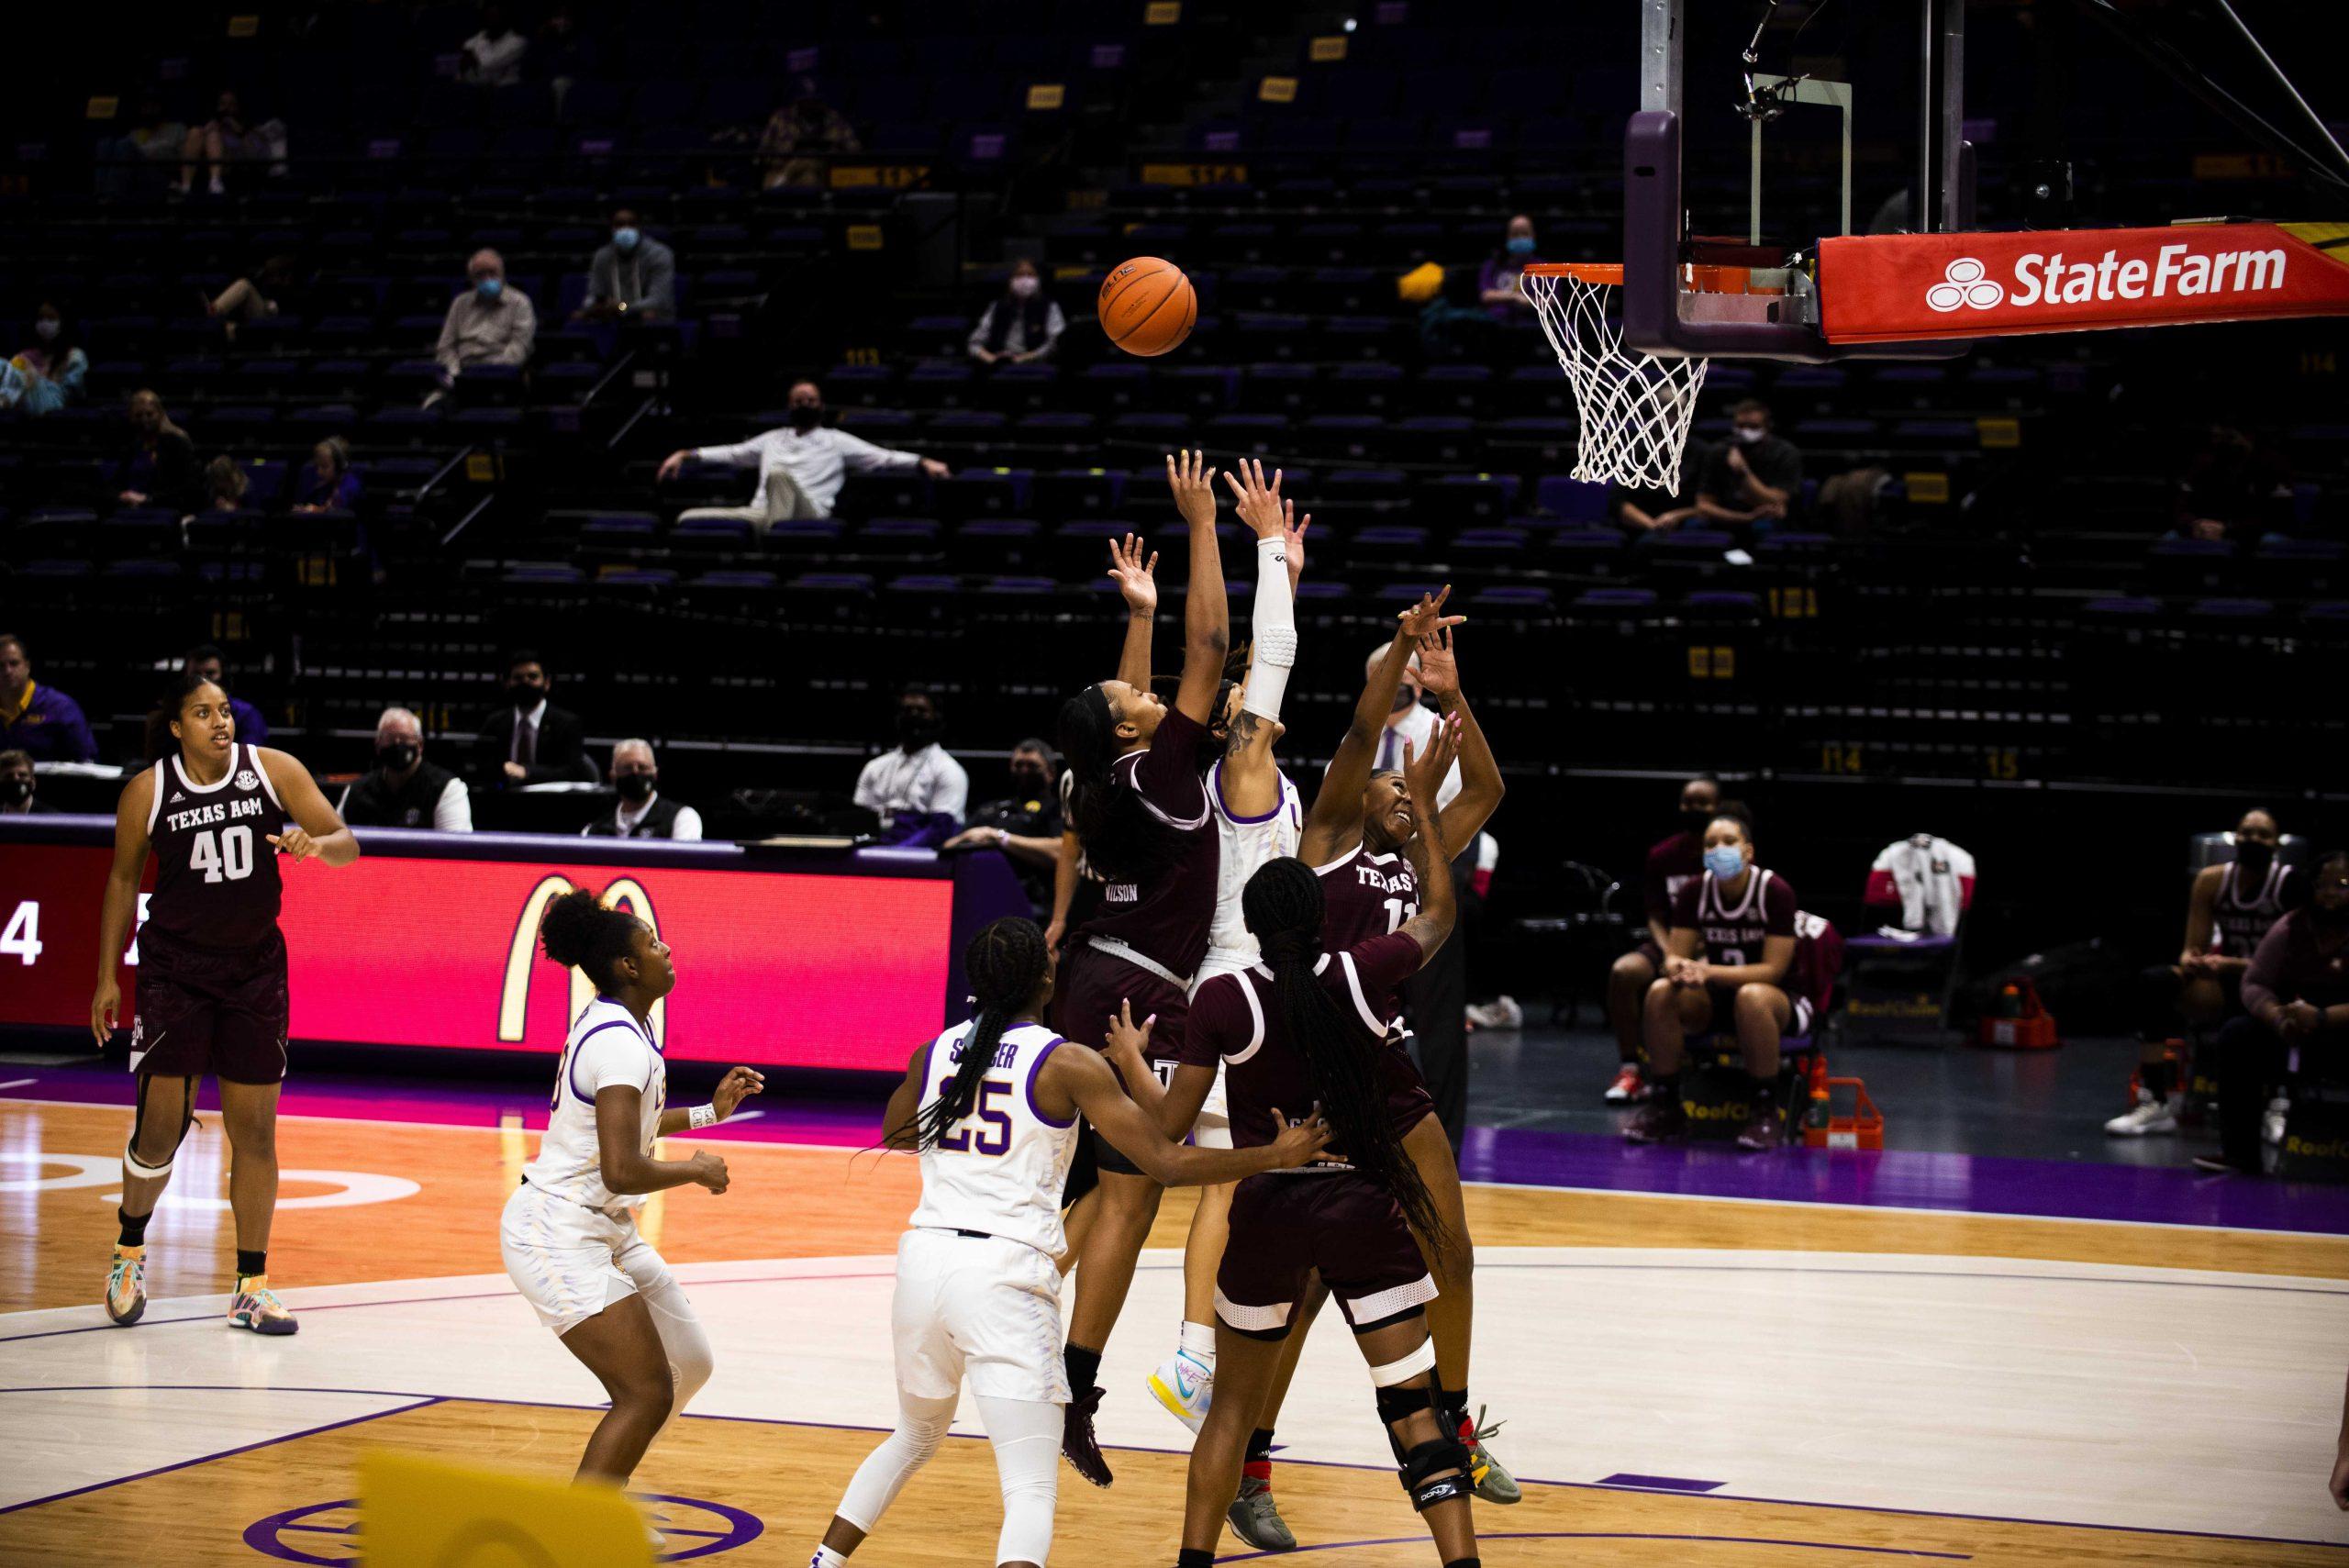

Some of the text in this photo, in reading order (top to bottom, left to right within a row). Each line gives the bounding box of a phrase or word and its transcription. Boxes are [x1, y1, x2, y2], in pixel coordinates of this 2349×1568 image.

[166, 796, 263, 832] TEXAS A&M
[189, 825, 254, 884] 40
[1355, 864, 1413, 894] TEXAS
[938, 1075, 1013, 1156] 25
